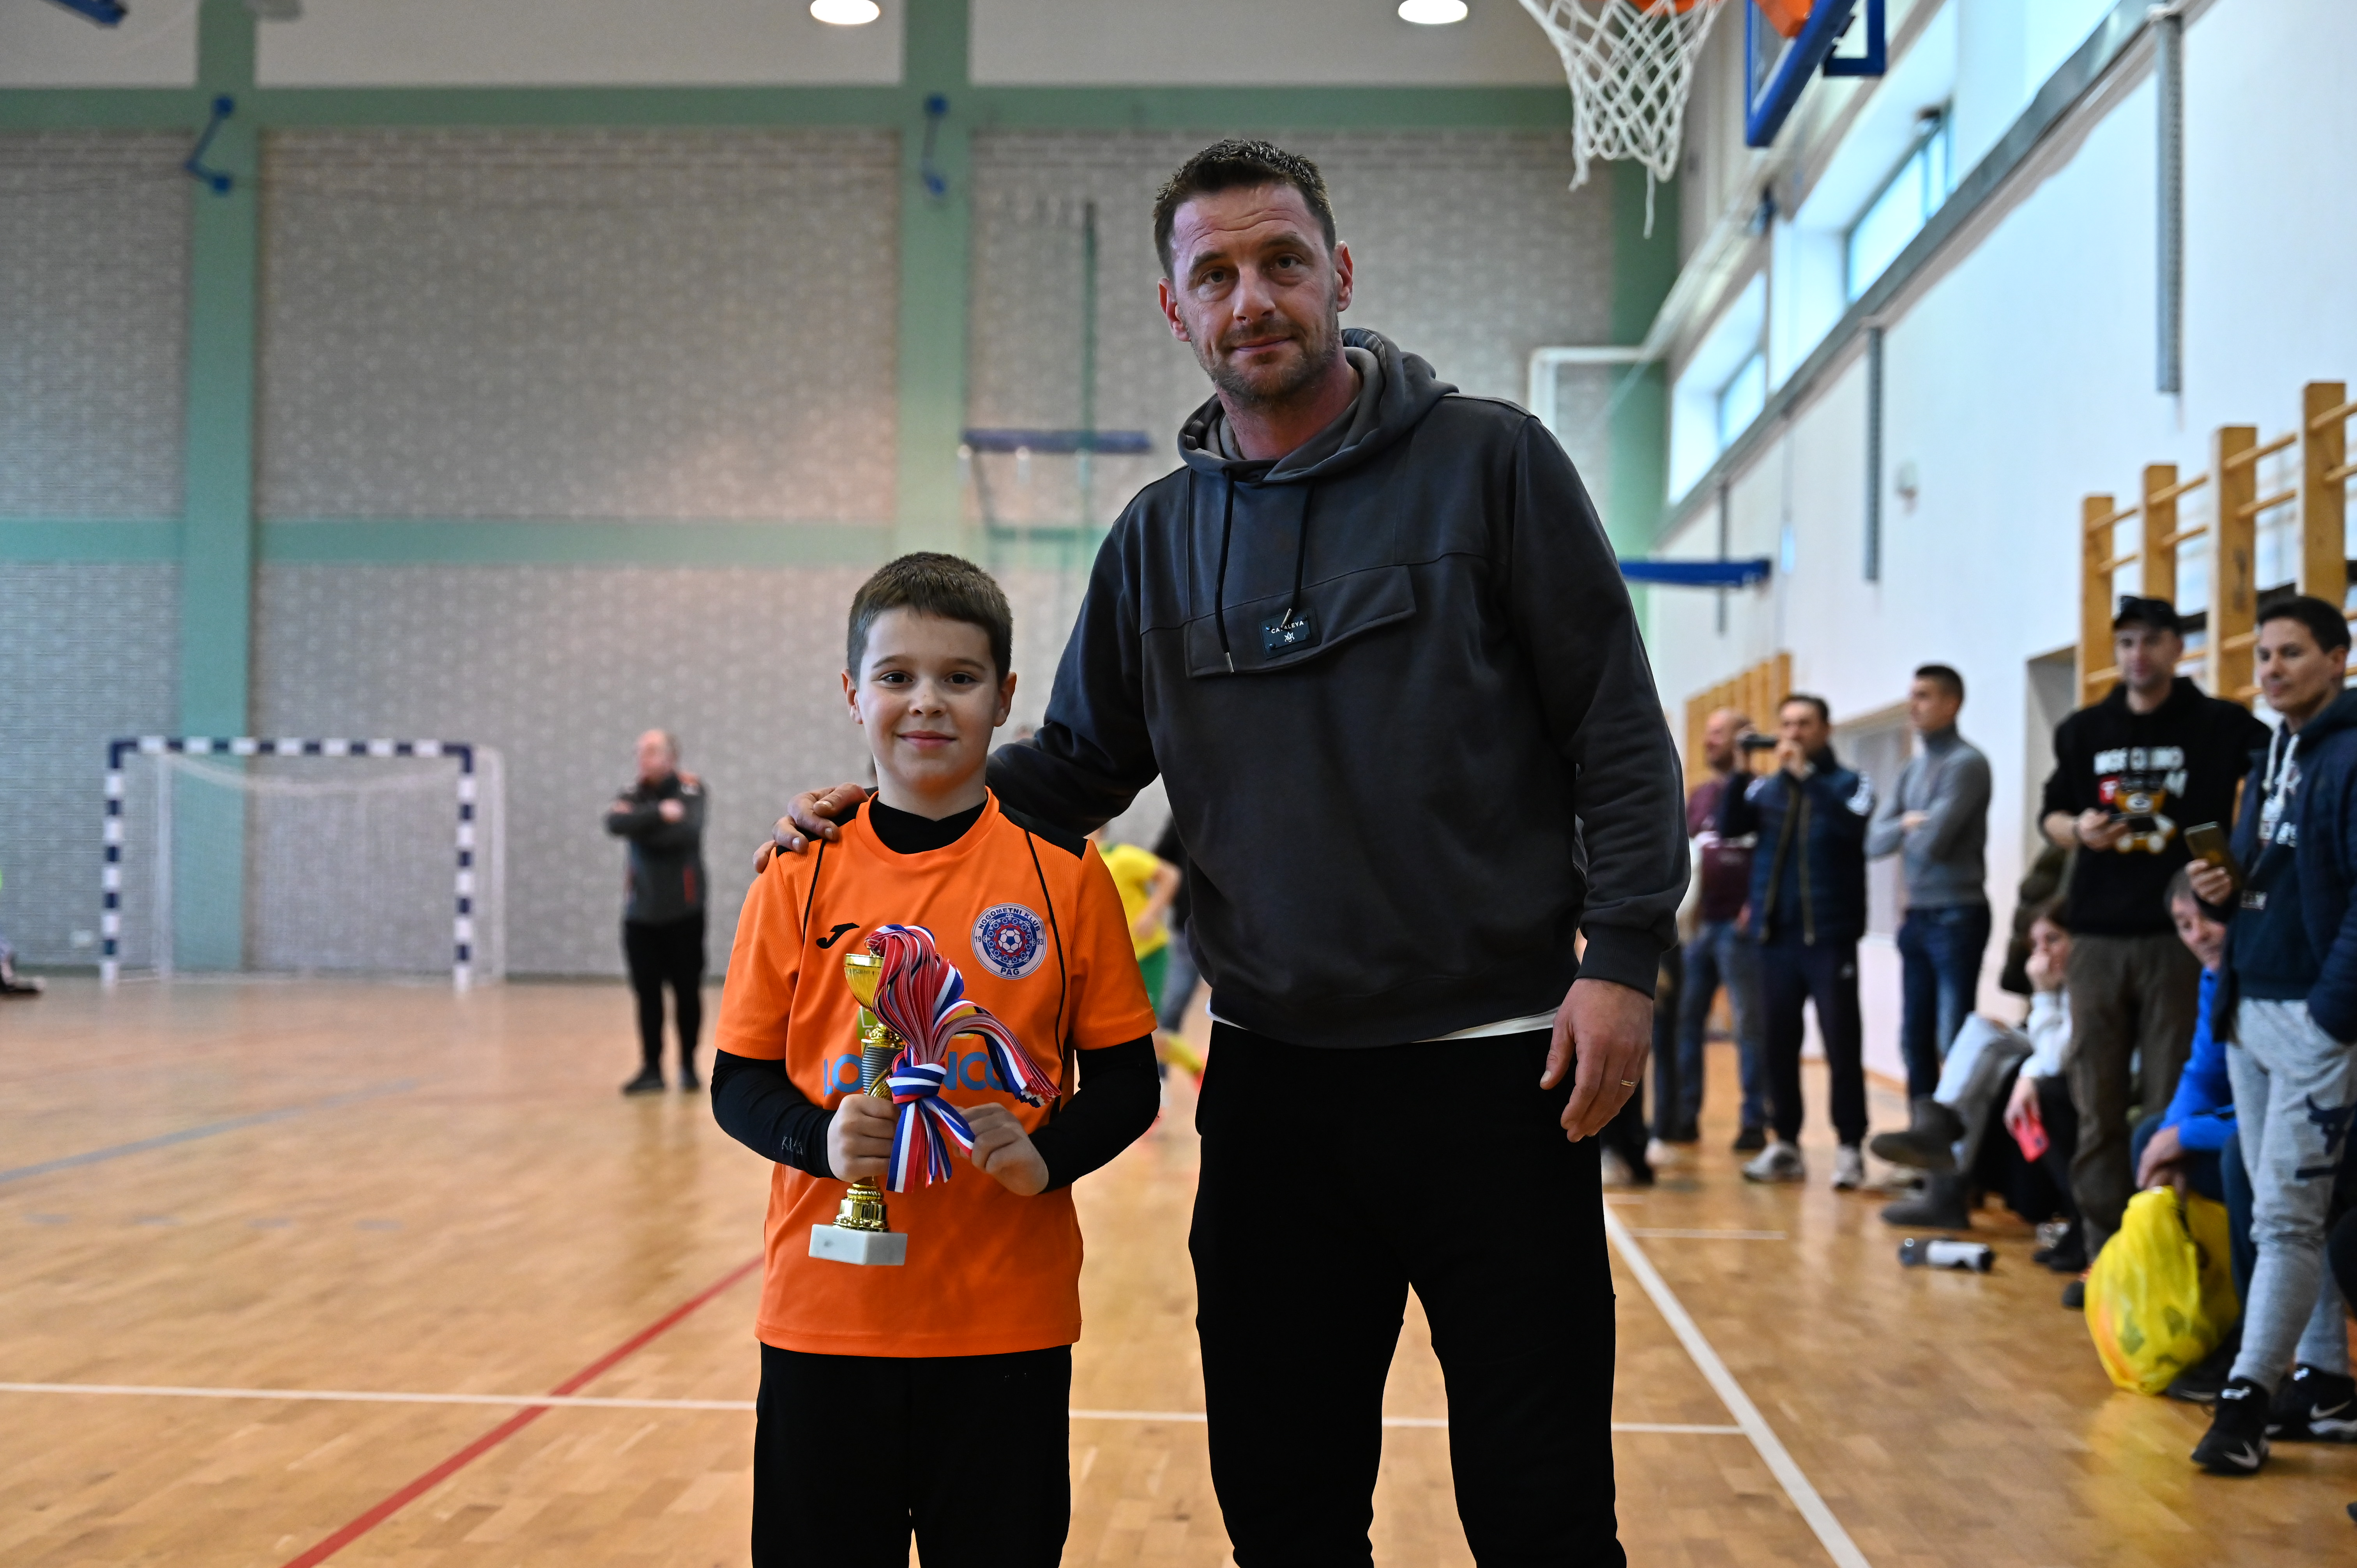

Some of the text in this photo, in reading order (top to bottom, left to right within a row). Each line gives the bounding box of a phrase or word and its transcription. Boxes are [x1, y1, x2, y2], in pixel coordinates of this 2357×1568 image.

[1271, 620, 1304, 634] CAALEYA
[978, 908, 1041, 932] NOGOMETNI KLUB
[1000, 967, 1019, 976] PAG
